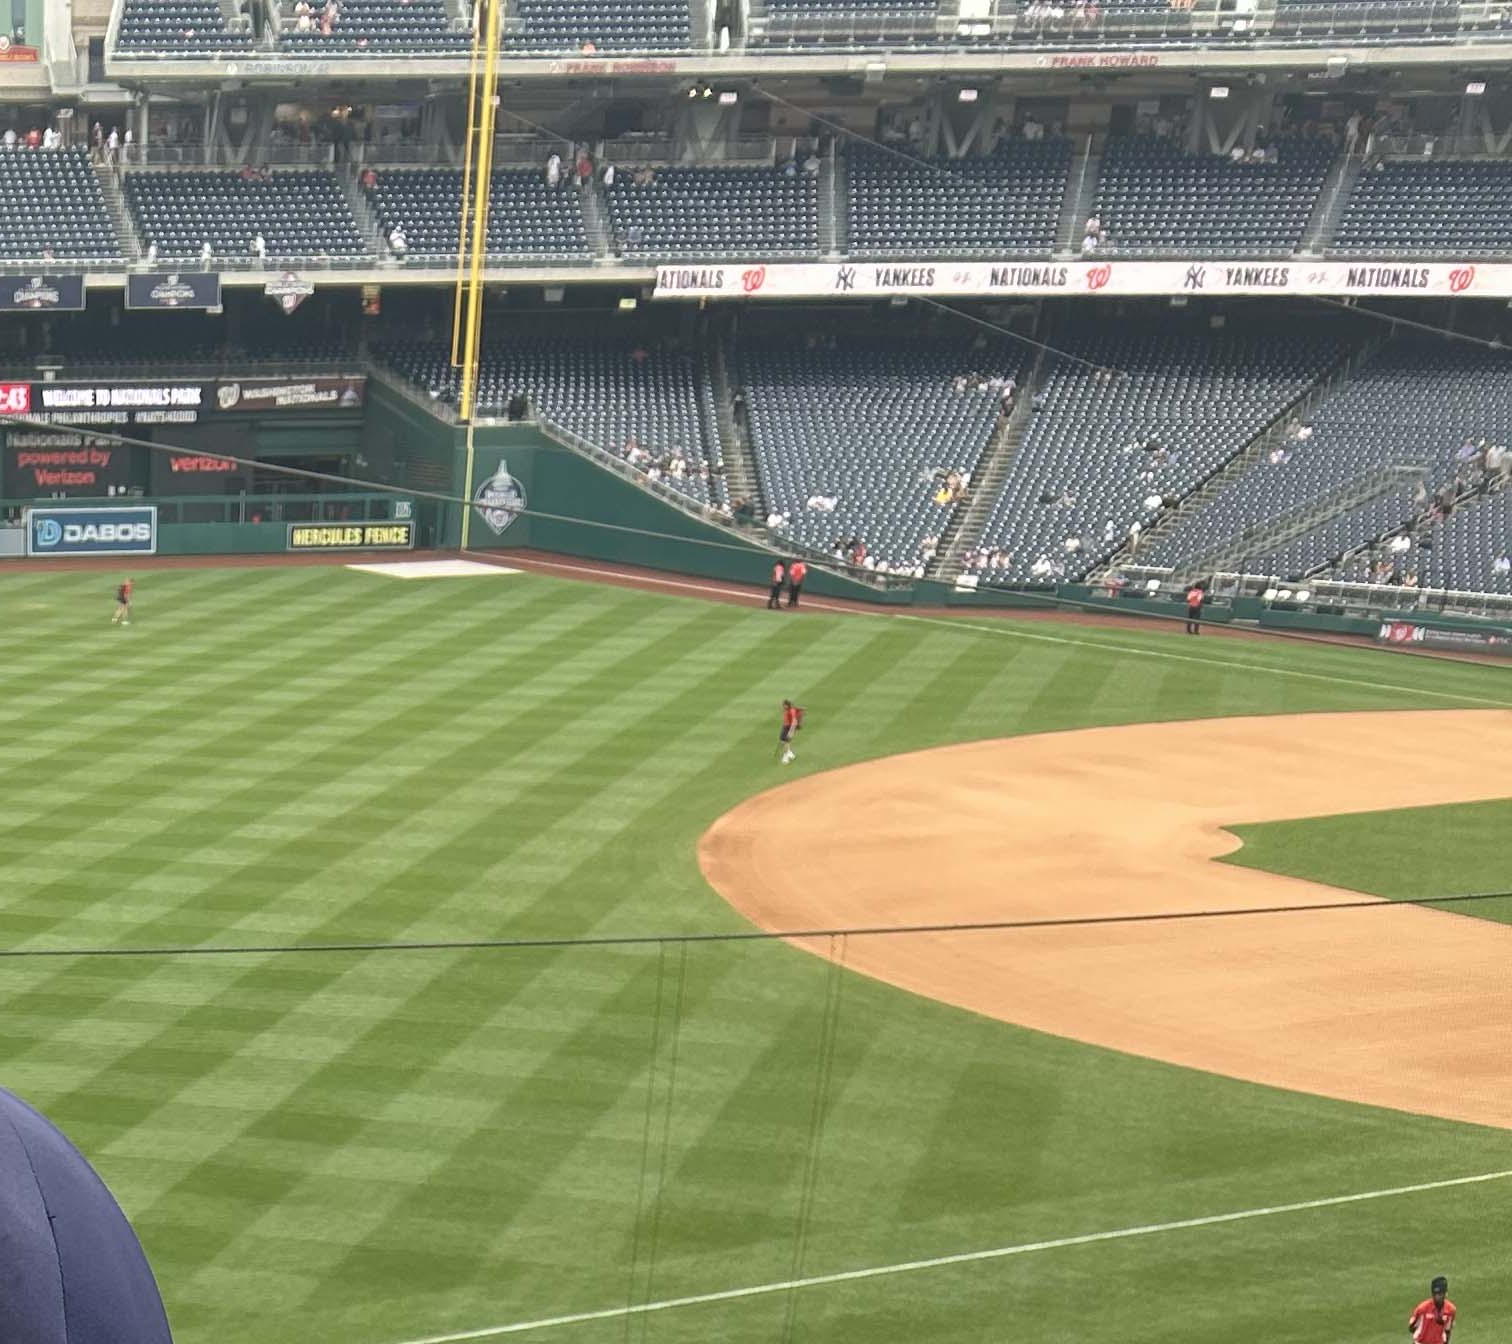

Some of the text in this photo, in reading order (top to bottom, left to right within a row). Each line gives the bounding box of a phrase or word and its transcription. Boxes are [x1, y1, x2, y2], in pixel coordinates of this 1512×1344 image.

[1051, 54, 1159, 67] FRANK HOWARD
[657, 269, 725, 290] ATIONALS
[874, 268, 937, 288] YANKEES
[989, 267, 1069, 288] NATIONALS
[1226, 267, 1290, 288] YANKEES
[1346, 267, 1430, 289] NATIONALS
[42, 389, 96, 407] WELCOME
[96, 389, 110, 406] TO
[111, 388, 170, 406] NATIONALS
[171, 387, 202, 405] PARK
[18, 448, 112, 468] powered by
[170, 457, 237, 472] verizon
[35, 469, 97, 486] Verizon
[63, 523, 151, 543] DABOS
[292, 526, 409, 546] HERCULES FENCE
